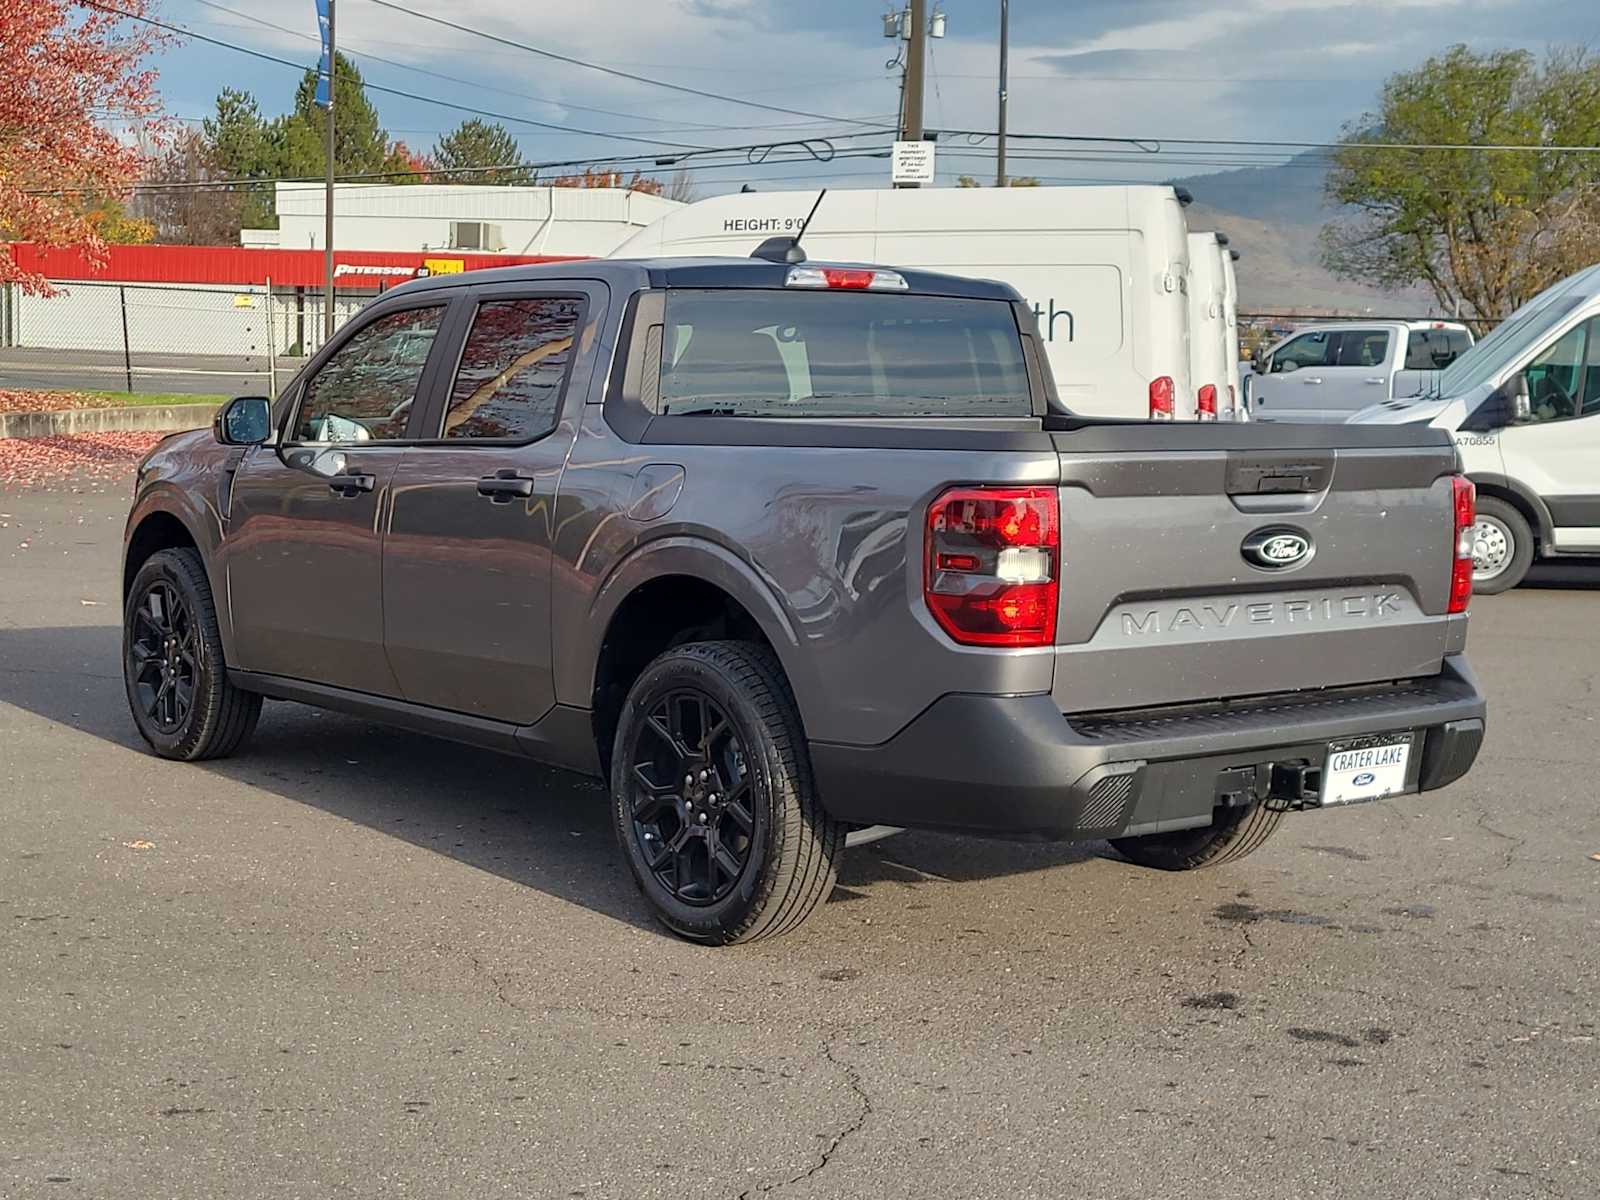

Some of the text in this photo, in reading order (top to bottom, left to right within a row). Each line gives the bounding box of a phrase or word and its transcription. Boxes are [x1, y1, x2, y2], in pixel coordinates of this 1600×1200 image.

[724, 218, 781, 231] HEIGHT:
[334, 264, 415, 277] PETERSON
[1268, 538, 1301, 558] Ford
[1120, 592, 1401, 635] MAVERICK
[1333, 747, 1403, 771] CRATER LAKE
